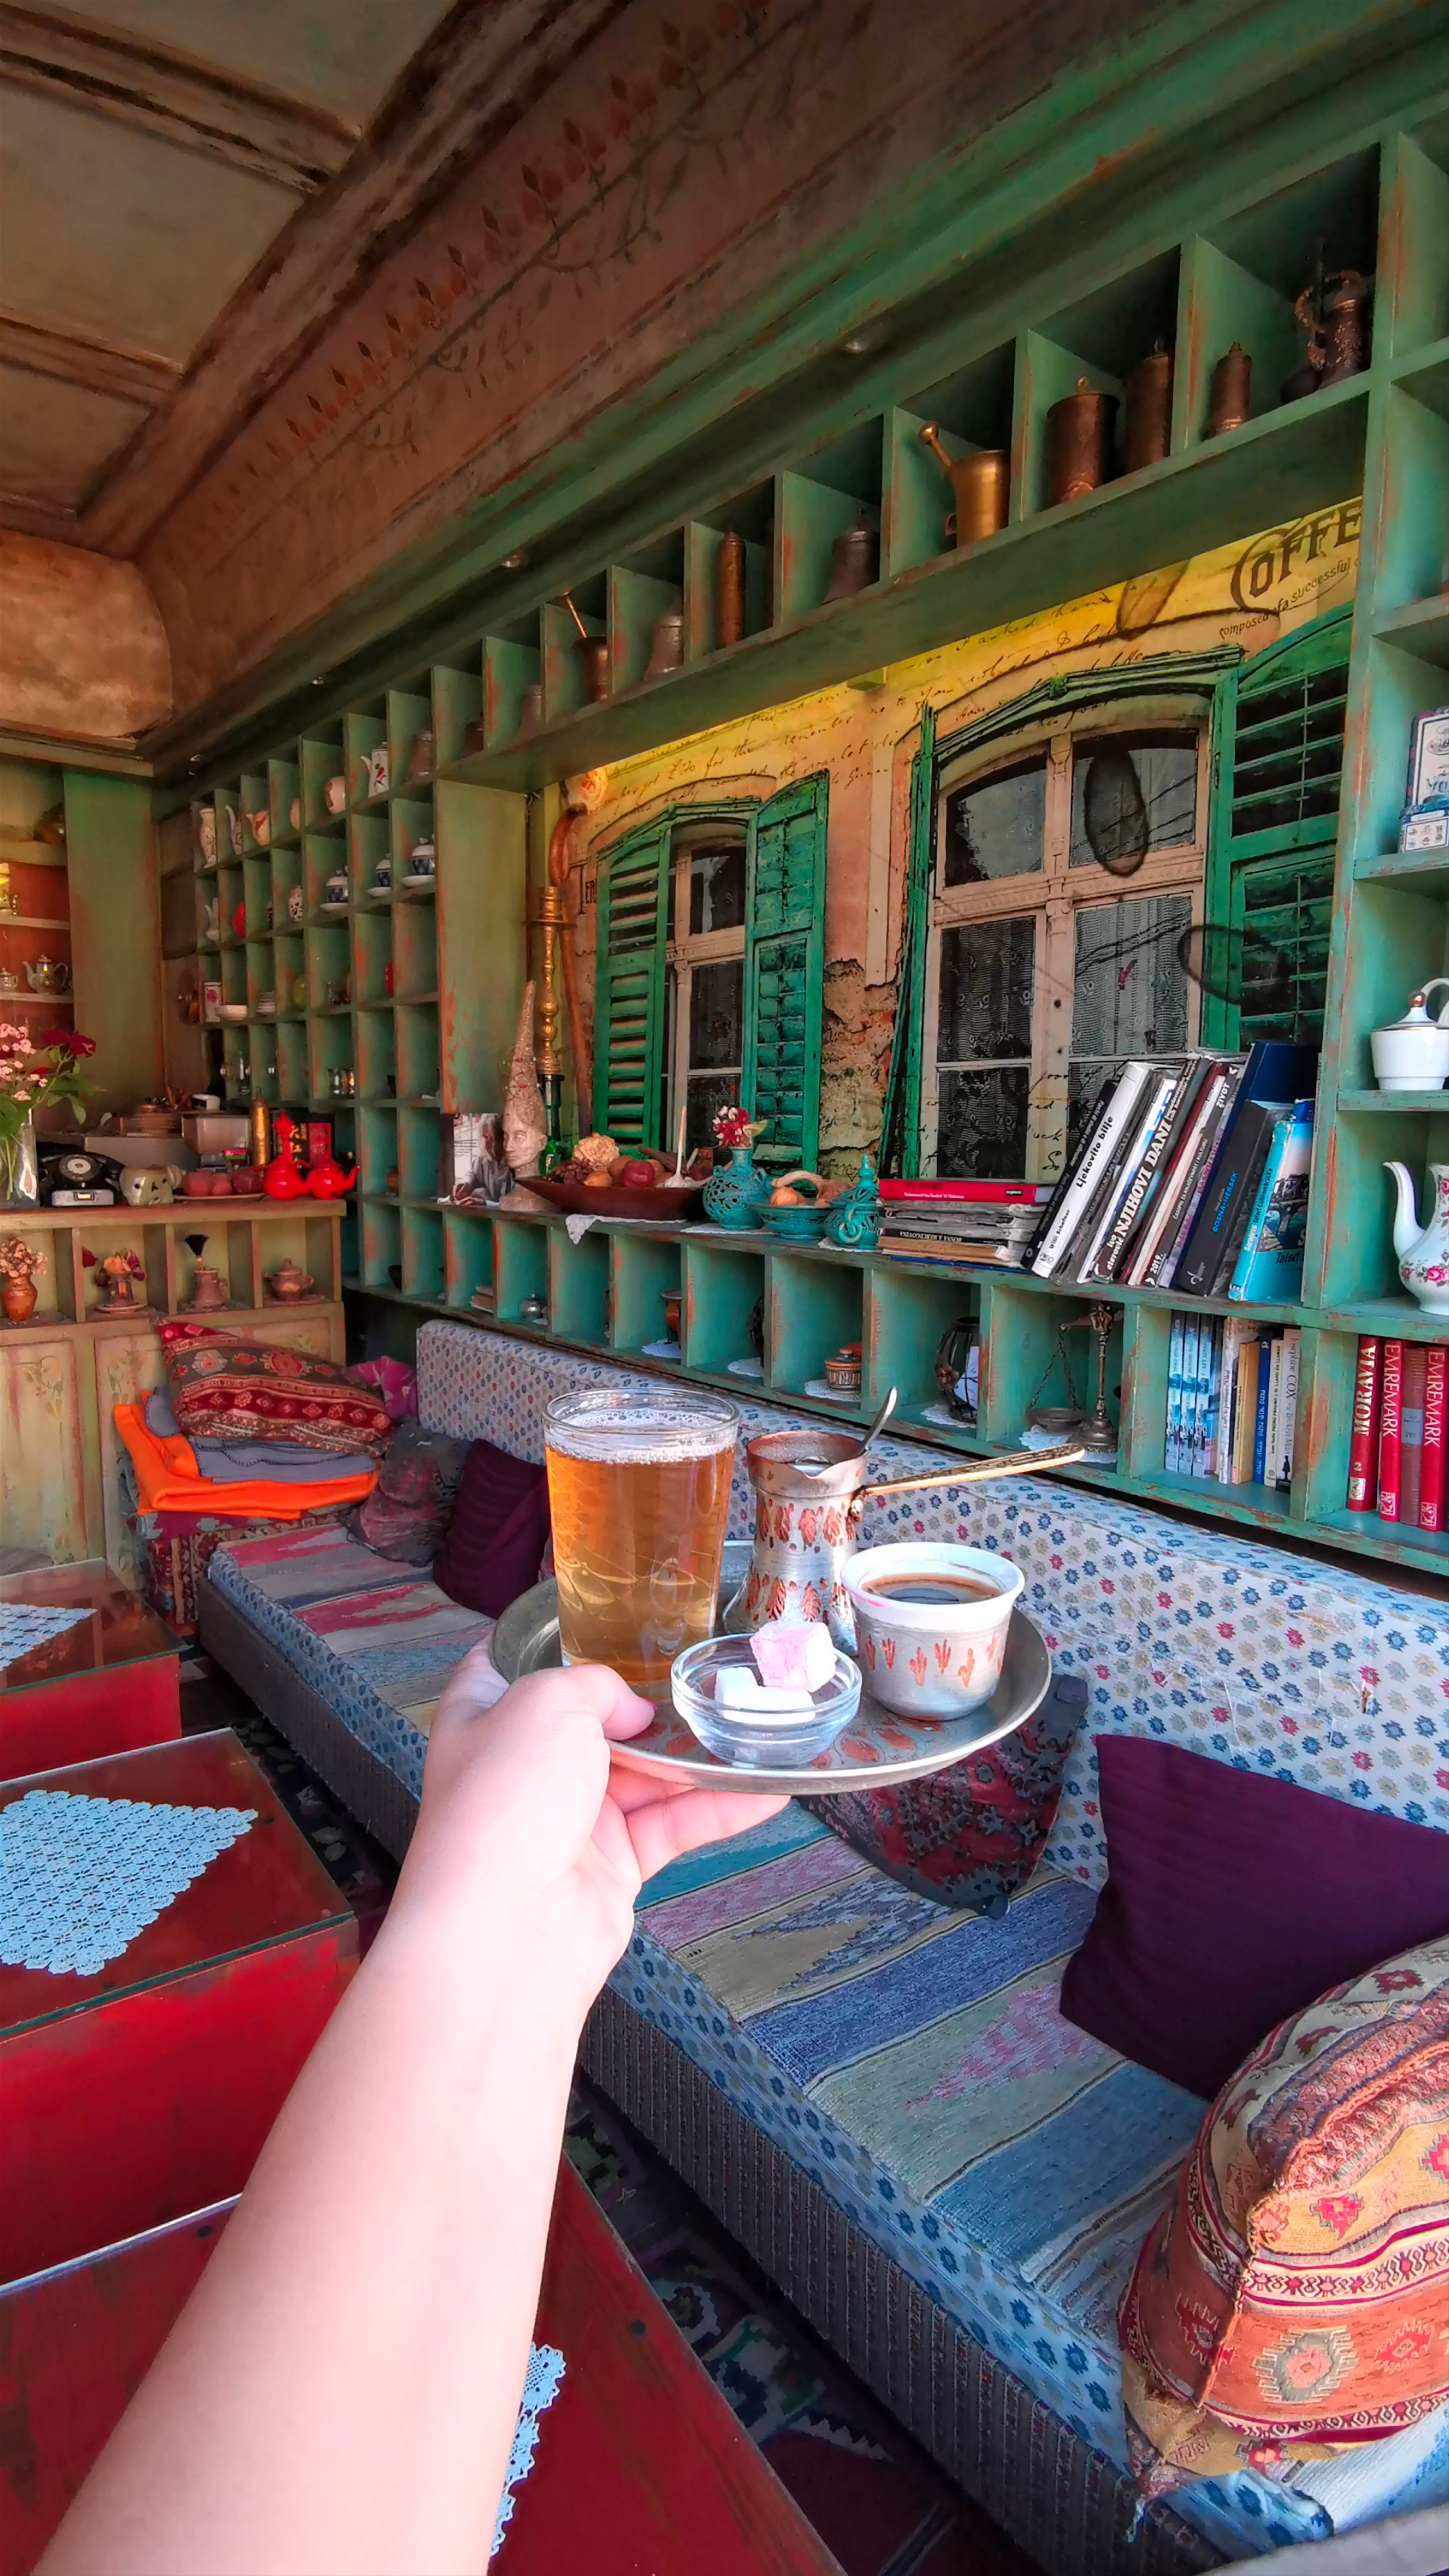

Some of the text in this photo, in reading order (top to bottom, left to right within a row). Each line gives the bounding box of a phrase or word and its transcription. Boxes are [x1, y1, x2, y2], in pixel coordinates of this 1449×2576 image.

[1219, 614, 1269, 640] composed
[1291, 558, 1352, 603] successful
[1075, 1116, 1114, 1189] Ljekovito bilje
[1116, 1120, 1173, 1236] NJIHOVI DANI
[1150, 1252, 1164, 1274] 2019.
[1286, 1375, 1297, 1399] COX
[1353, 1345, 1376, 1436] MORAVIA
